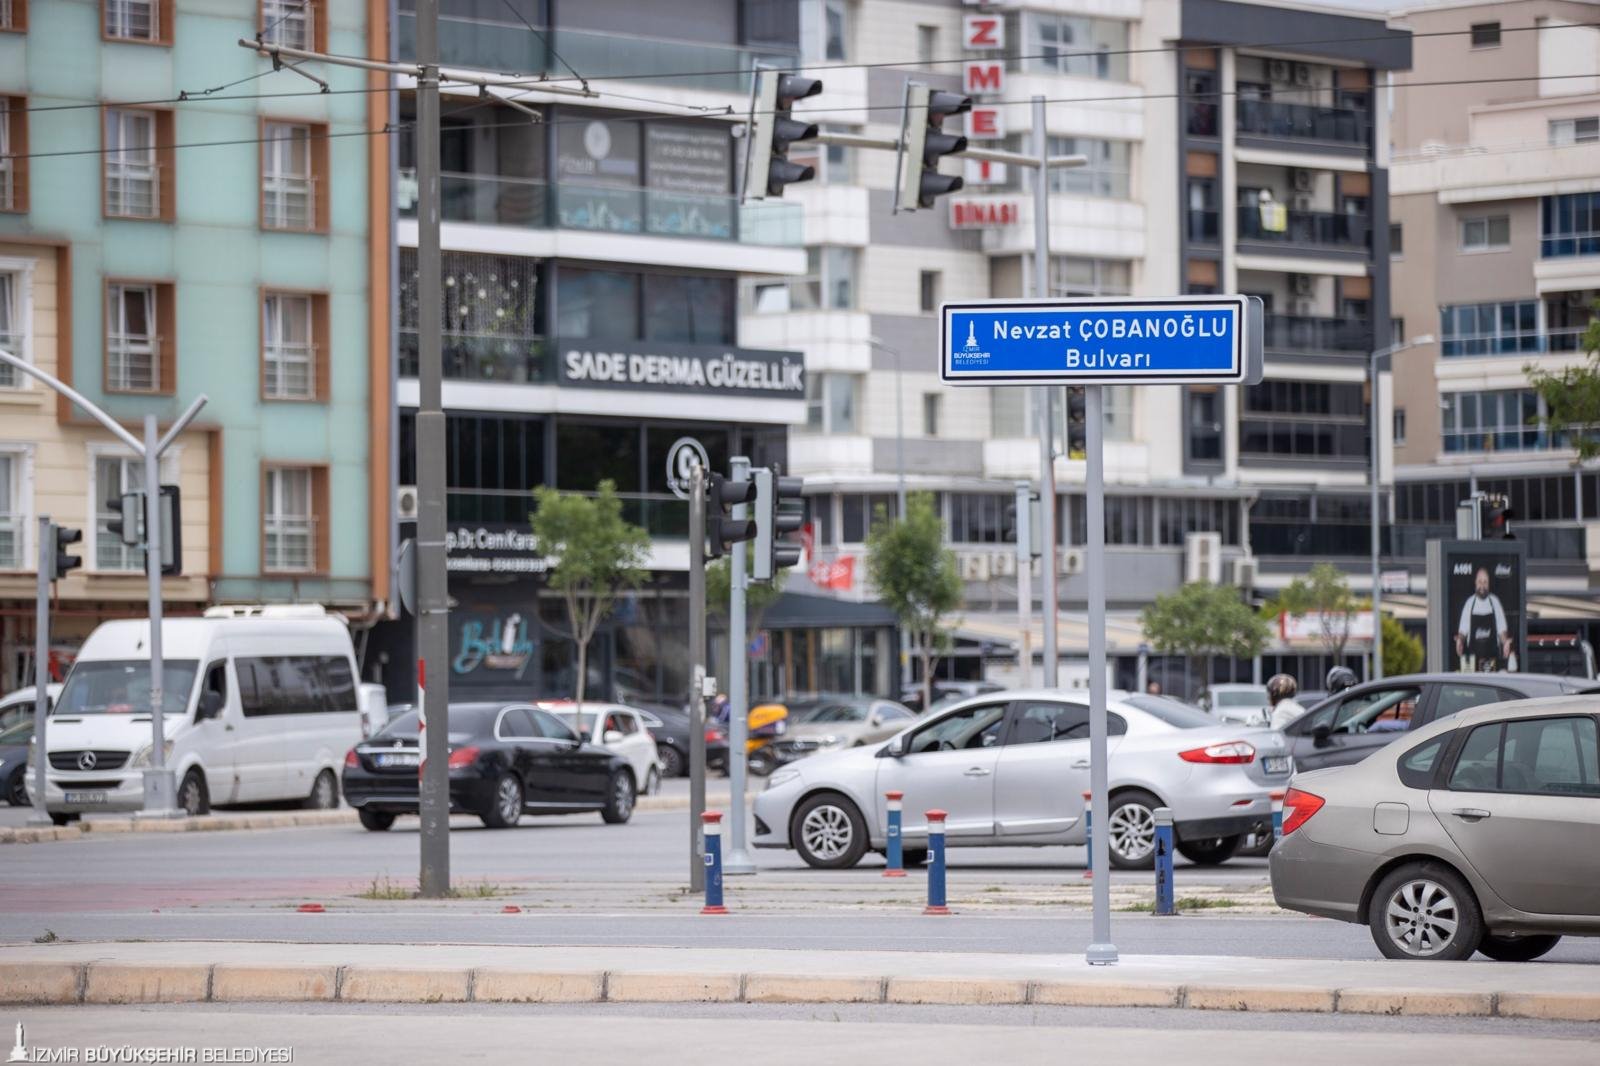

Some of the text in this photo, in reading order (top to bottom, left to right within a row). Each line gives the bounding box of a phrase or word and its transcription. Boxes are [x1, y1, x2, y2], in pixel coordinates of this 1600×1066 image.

[993, 315, 1228, 341] Nevzat ÇOBANOĞLU
[566, 351, 804, 391] SADE DERMA GÜZELLİK
[1066, 349, 1151, 367] Bulvarı
